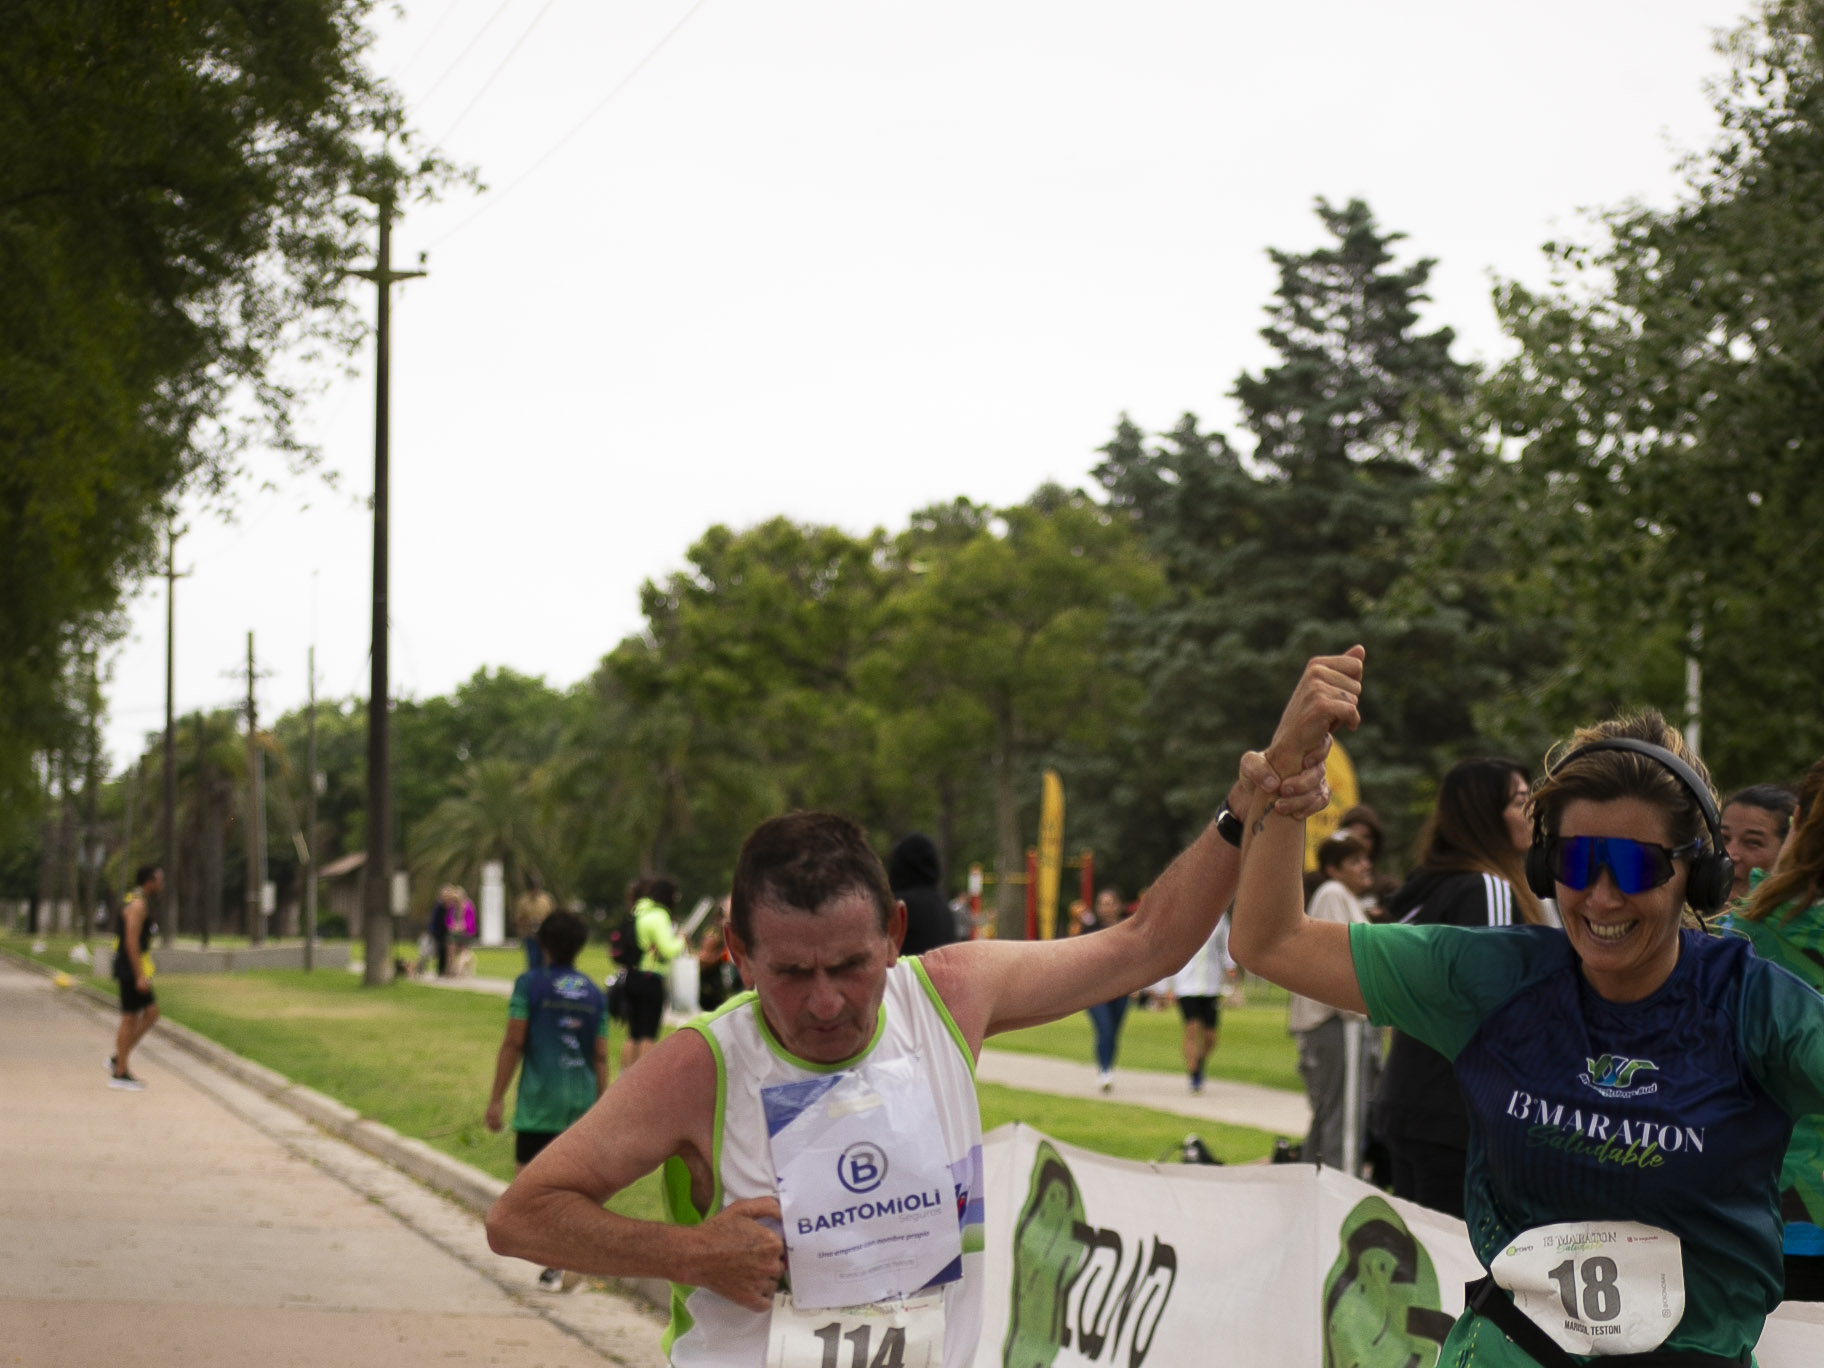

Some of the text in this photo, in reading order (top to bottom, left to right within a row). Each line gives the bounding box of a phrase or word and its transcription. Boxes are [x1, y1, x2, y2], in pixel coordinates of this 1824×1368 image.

[1524, 1099, 1705, 1153] MARATON
[1527, 1124, 1665, 1168] Saludable
[851, 1152, 878, 1185] B
[797, 1188, 941, 1235] BARTOMIOLI
[1557, 1232, 1617, 1247] MARATON
[1548, 1256, 1621, 1322] 18
[1564, 1320, 1621, 1336] MARISOL TESTONI
